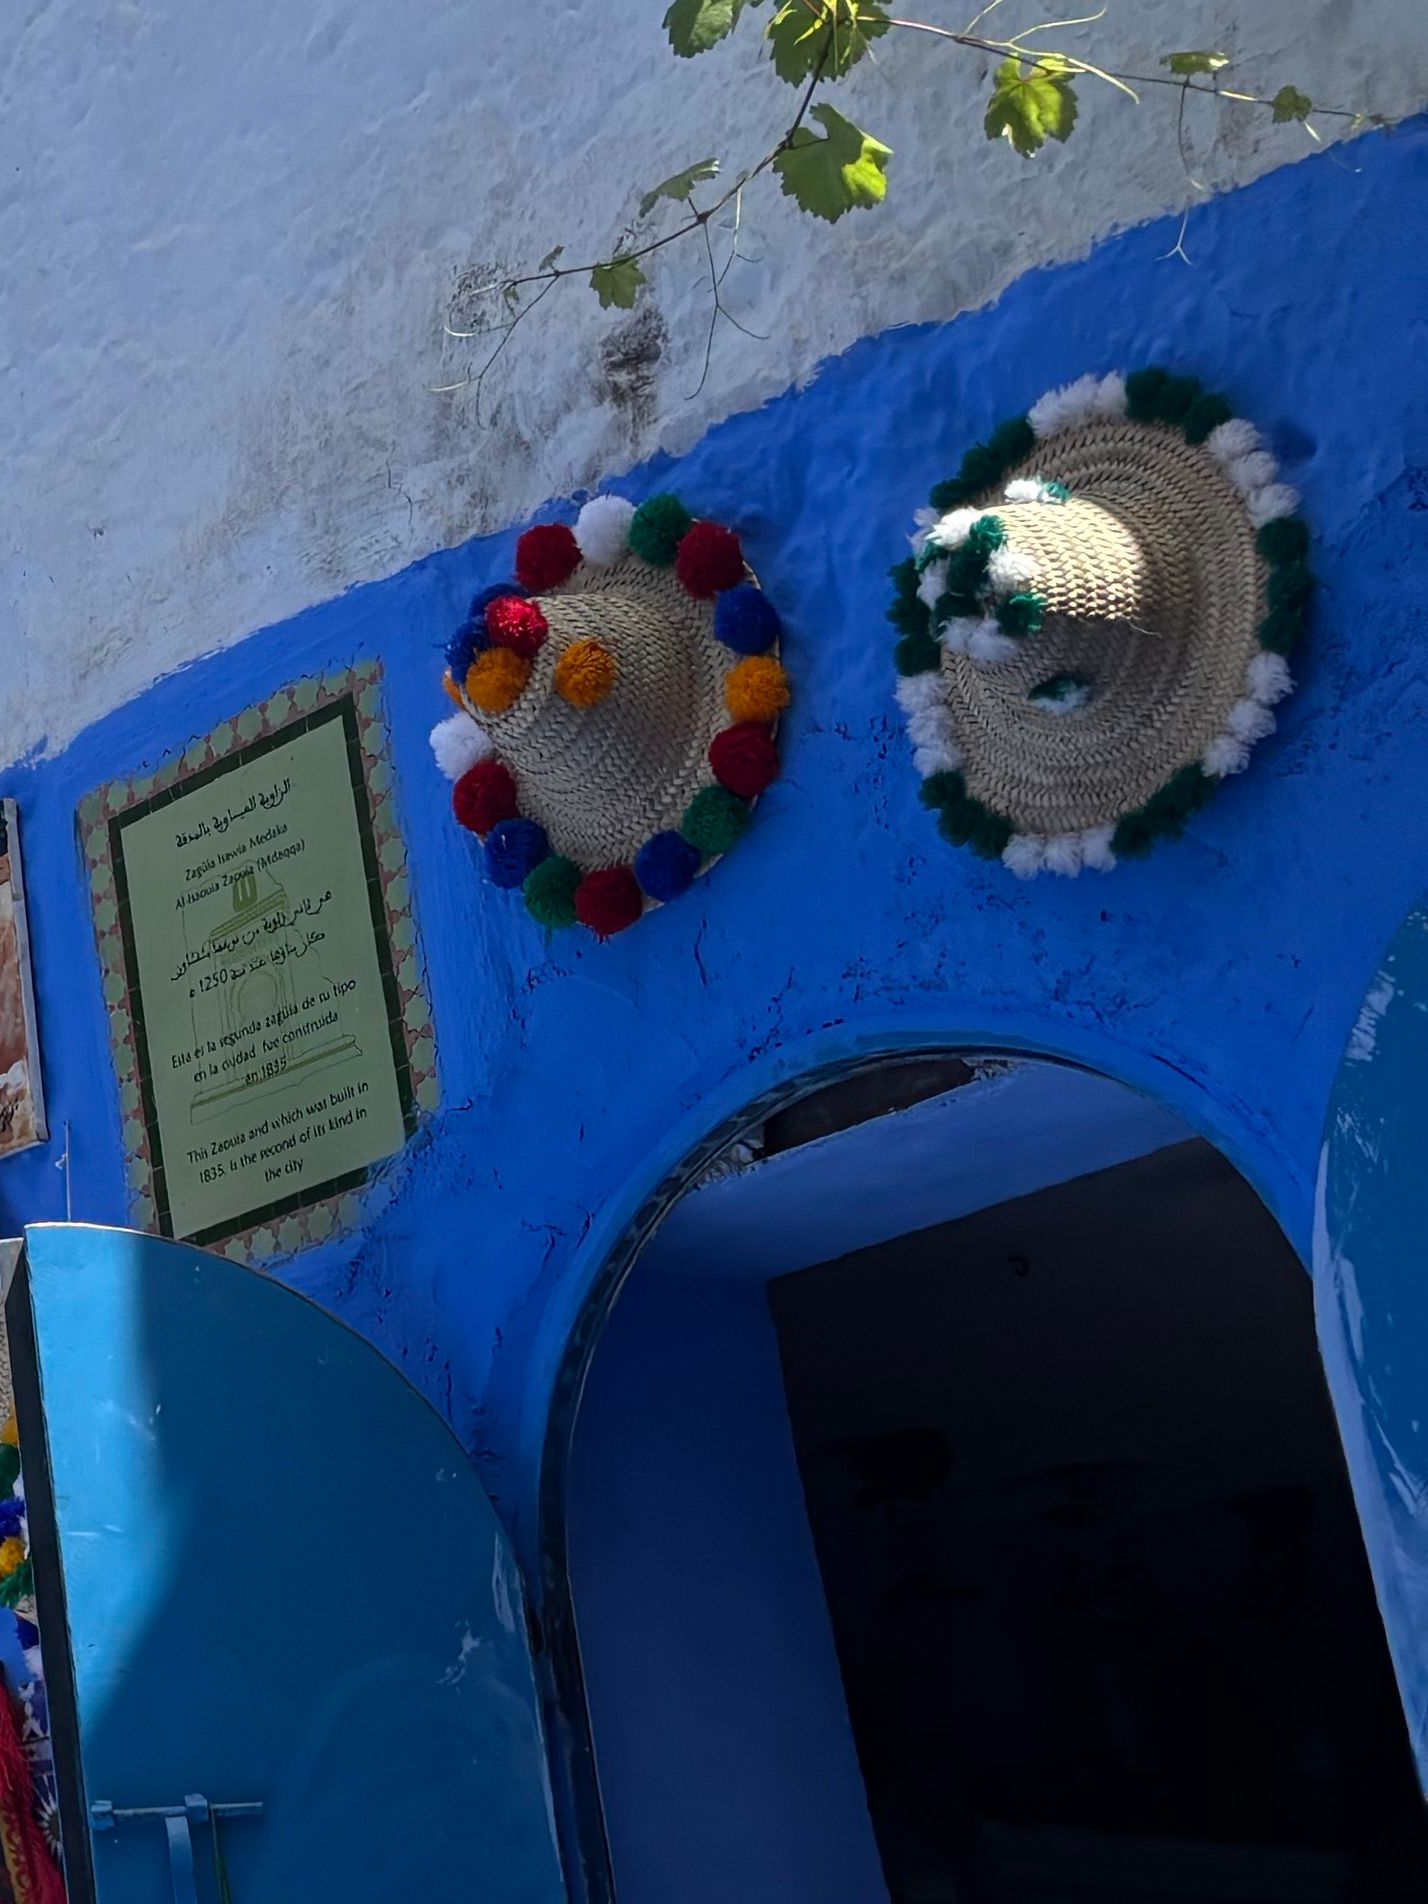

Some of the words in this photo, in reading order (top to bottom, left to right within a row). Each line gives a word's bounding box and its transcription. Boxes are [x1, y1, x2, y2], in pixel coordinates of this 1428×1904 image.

[198, 968, 229, 993] 1250
[332, 979, 357, 998] tipo
[262, 1037, 280, 1054] fue
[281, 1010, 339, 1044] construida
[261, 1054, 287, 1080] 1835
[186, 1147, 209, 1164] This
[248, 1119, 269, 1140] and
[271, 1108, 304, 1130] which
[305, 1098, 328, 1116] was
[329, 1086, 355, 1106] built
[239, 1152, 258, 1168] the
[259, 1133, 297, 1161] second
[328, 1109, 354, 1131] kind
[264, 1167, 282, 1183] the
[284, 1158, 304, 1174] city
